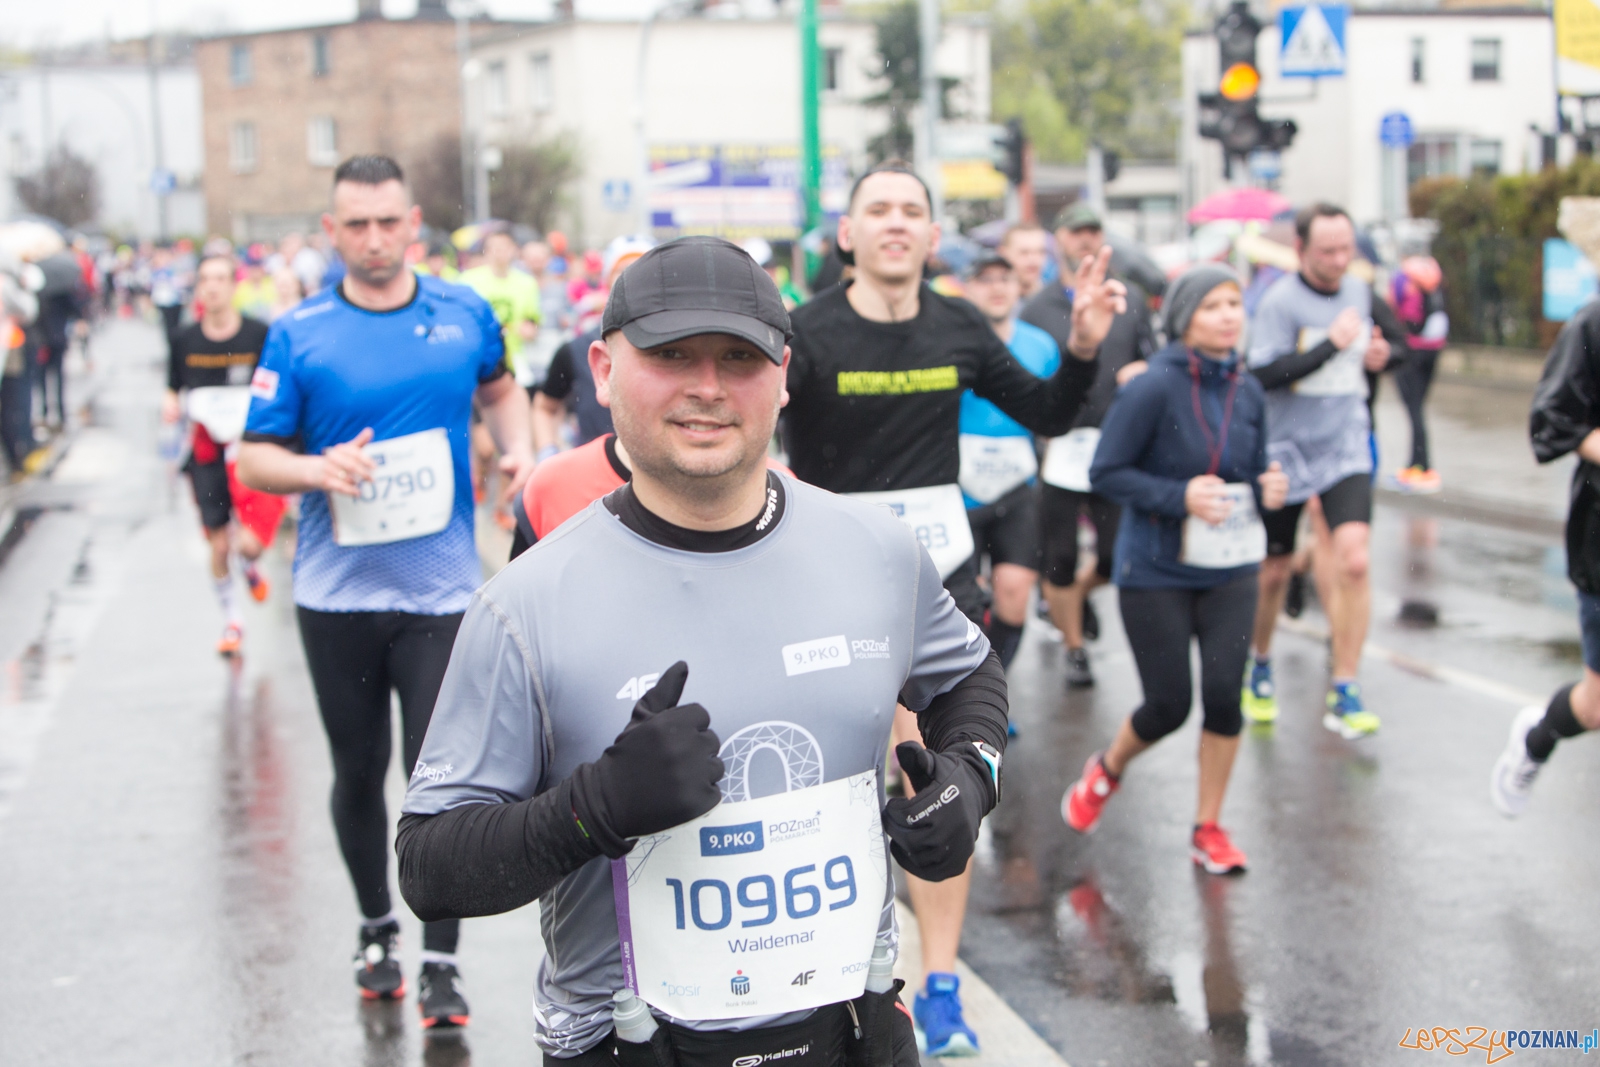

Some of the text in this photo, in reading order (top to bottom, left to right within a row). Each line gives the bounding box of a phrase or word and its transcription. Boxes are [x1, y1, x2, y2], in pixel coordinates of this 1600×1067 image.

[352, 466, 435, 504] 0790
[808, 646, 840, 663] PKO
[723, 831, 756, 848] PKO
[665, 855, 858, 931] 10969
[727, 930, 816, 954] Waldemar
[790, 969, 816, 986] 4F
[763, 1044, 810, 1062] Kalenji
